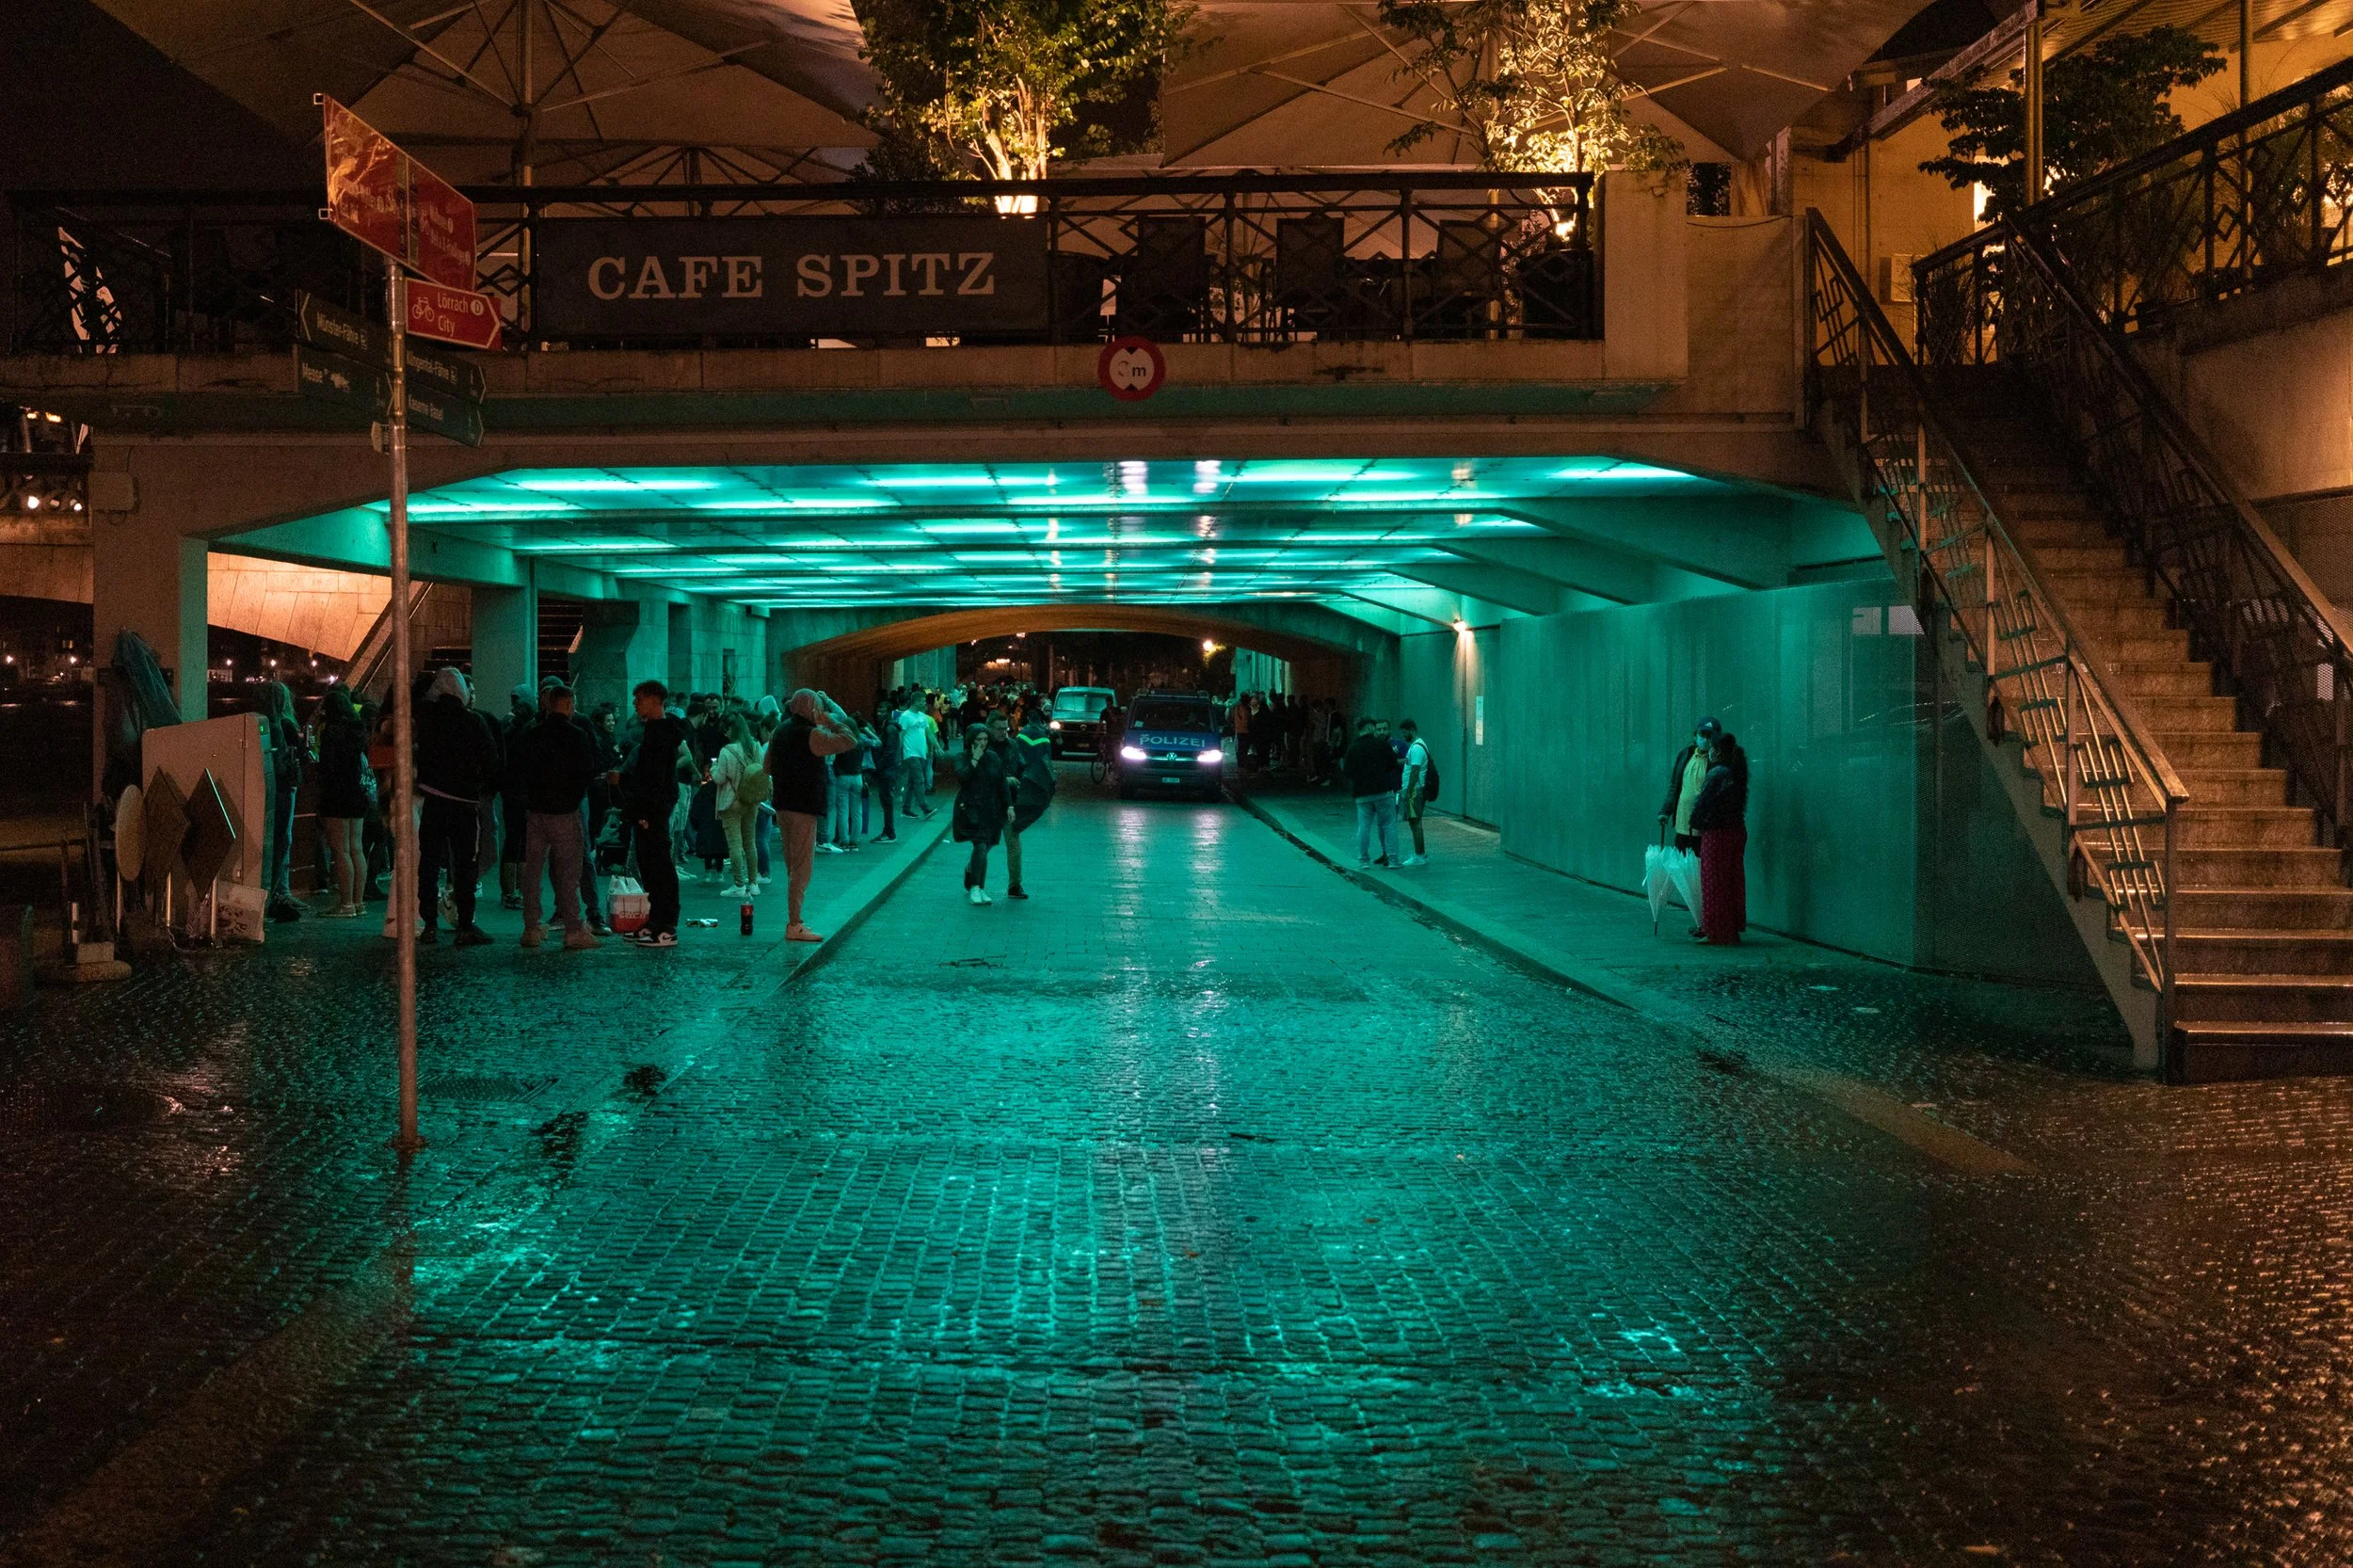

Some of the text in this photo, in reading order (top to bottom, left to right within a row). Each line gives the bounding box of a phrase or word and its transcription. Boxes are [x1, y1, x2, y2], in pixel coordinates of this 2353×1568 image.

[587, 252, 996, 300] CAFE SPITZ
[437, 292, 469, 314] Lörrach
[438, 314, 456, 338] City
[1139, 736, 1206, 748] POLIZEI
